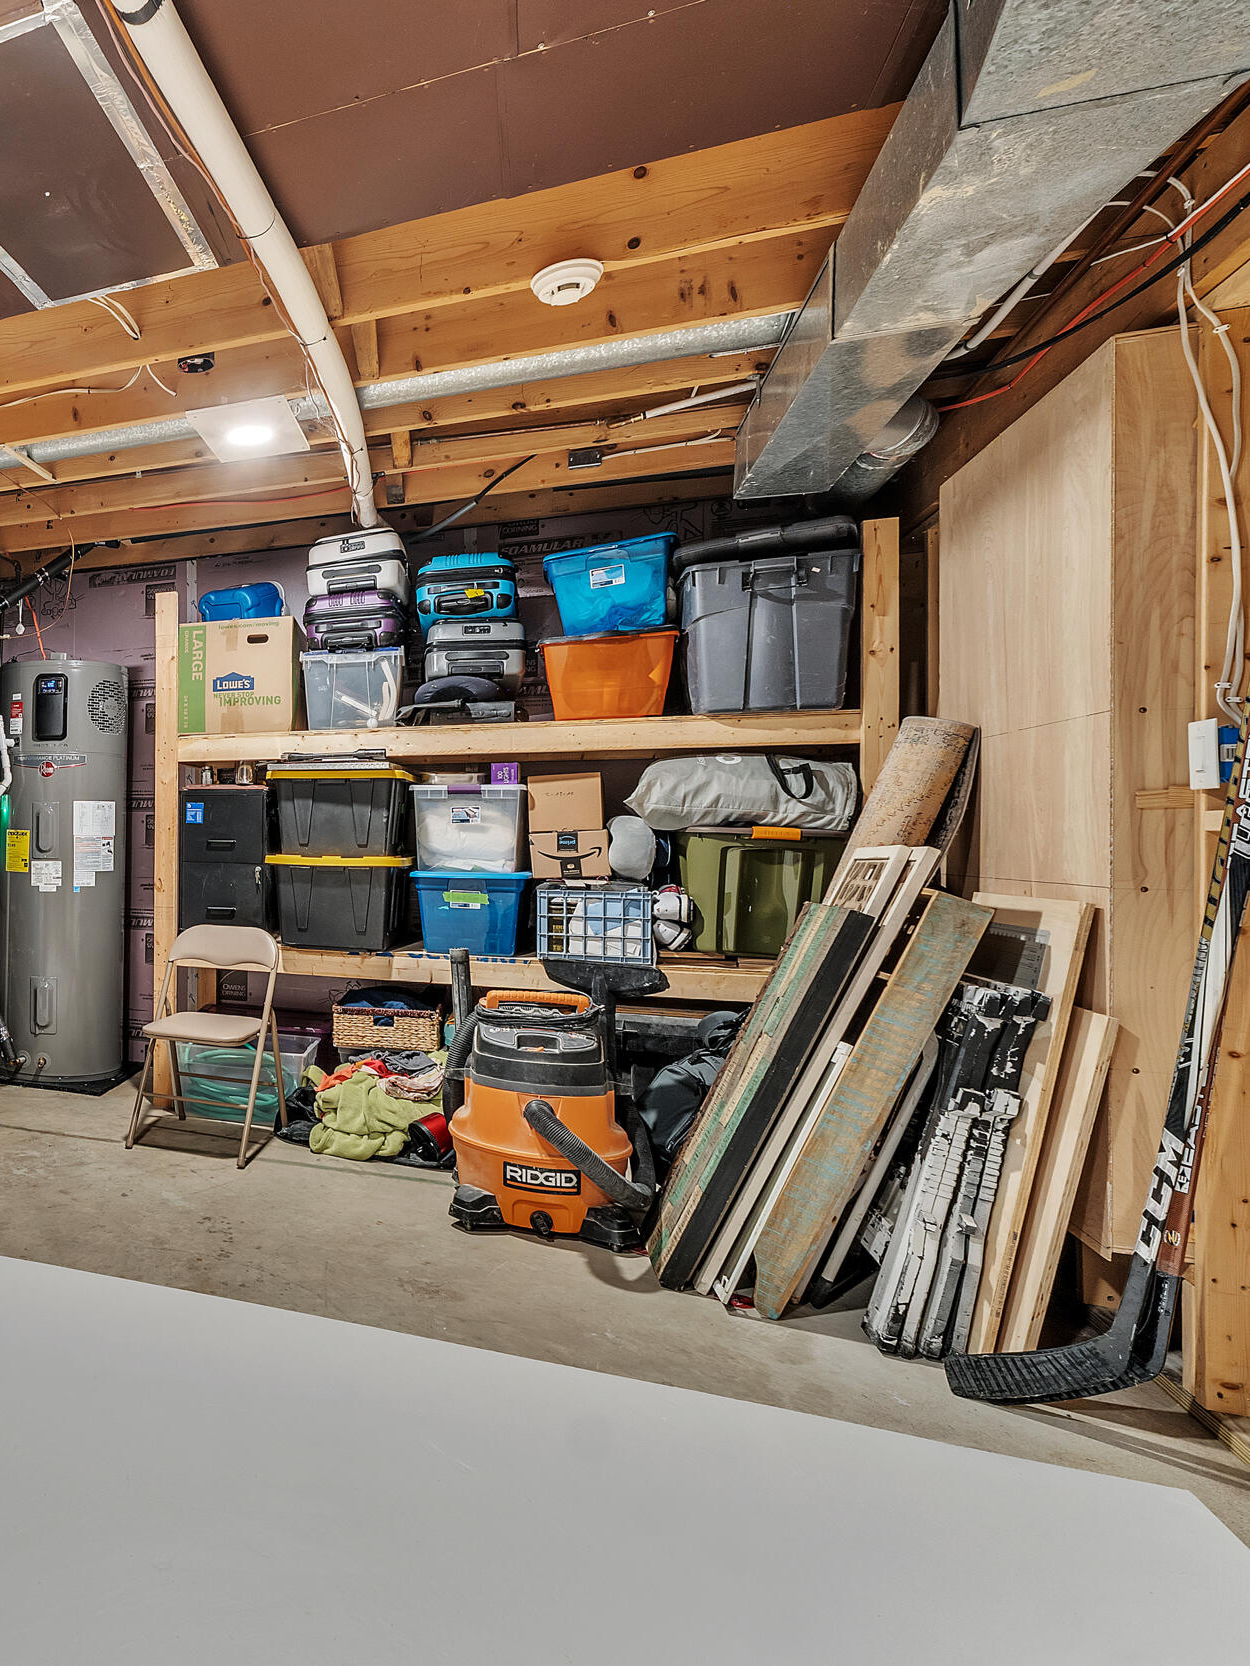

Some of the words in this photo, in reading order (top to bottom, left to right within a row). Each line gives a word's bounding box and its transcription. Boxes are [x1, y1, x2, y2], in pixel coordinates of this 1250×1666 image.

[502, 539, 584, 555] FOAMULAR
[218, 621, 280, 630] lowes.com/moving
[191, 630, 203, 681] LARGE
[216, 679, 251, 690] LOWE'S
[219, 695, 281, 707] IMPROVING
[222, 983, 246, 991] OWENS
[506, 1165, 578, 1188] RIDGID
[1135, 1127, 1185, 1265] CCM
